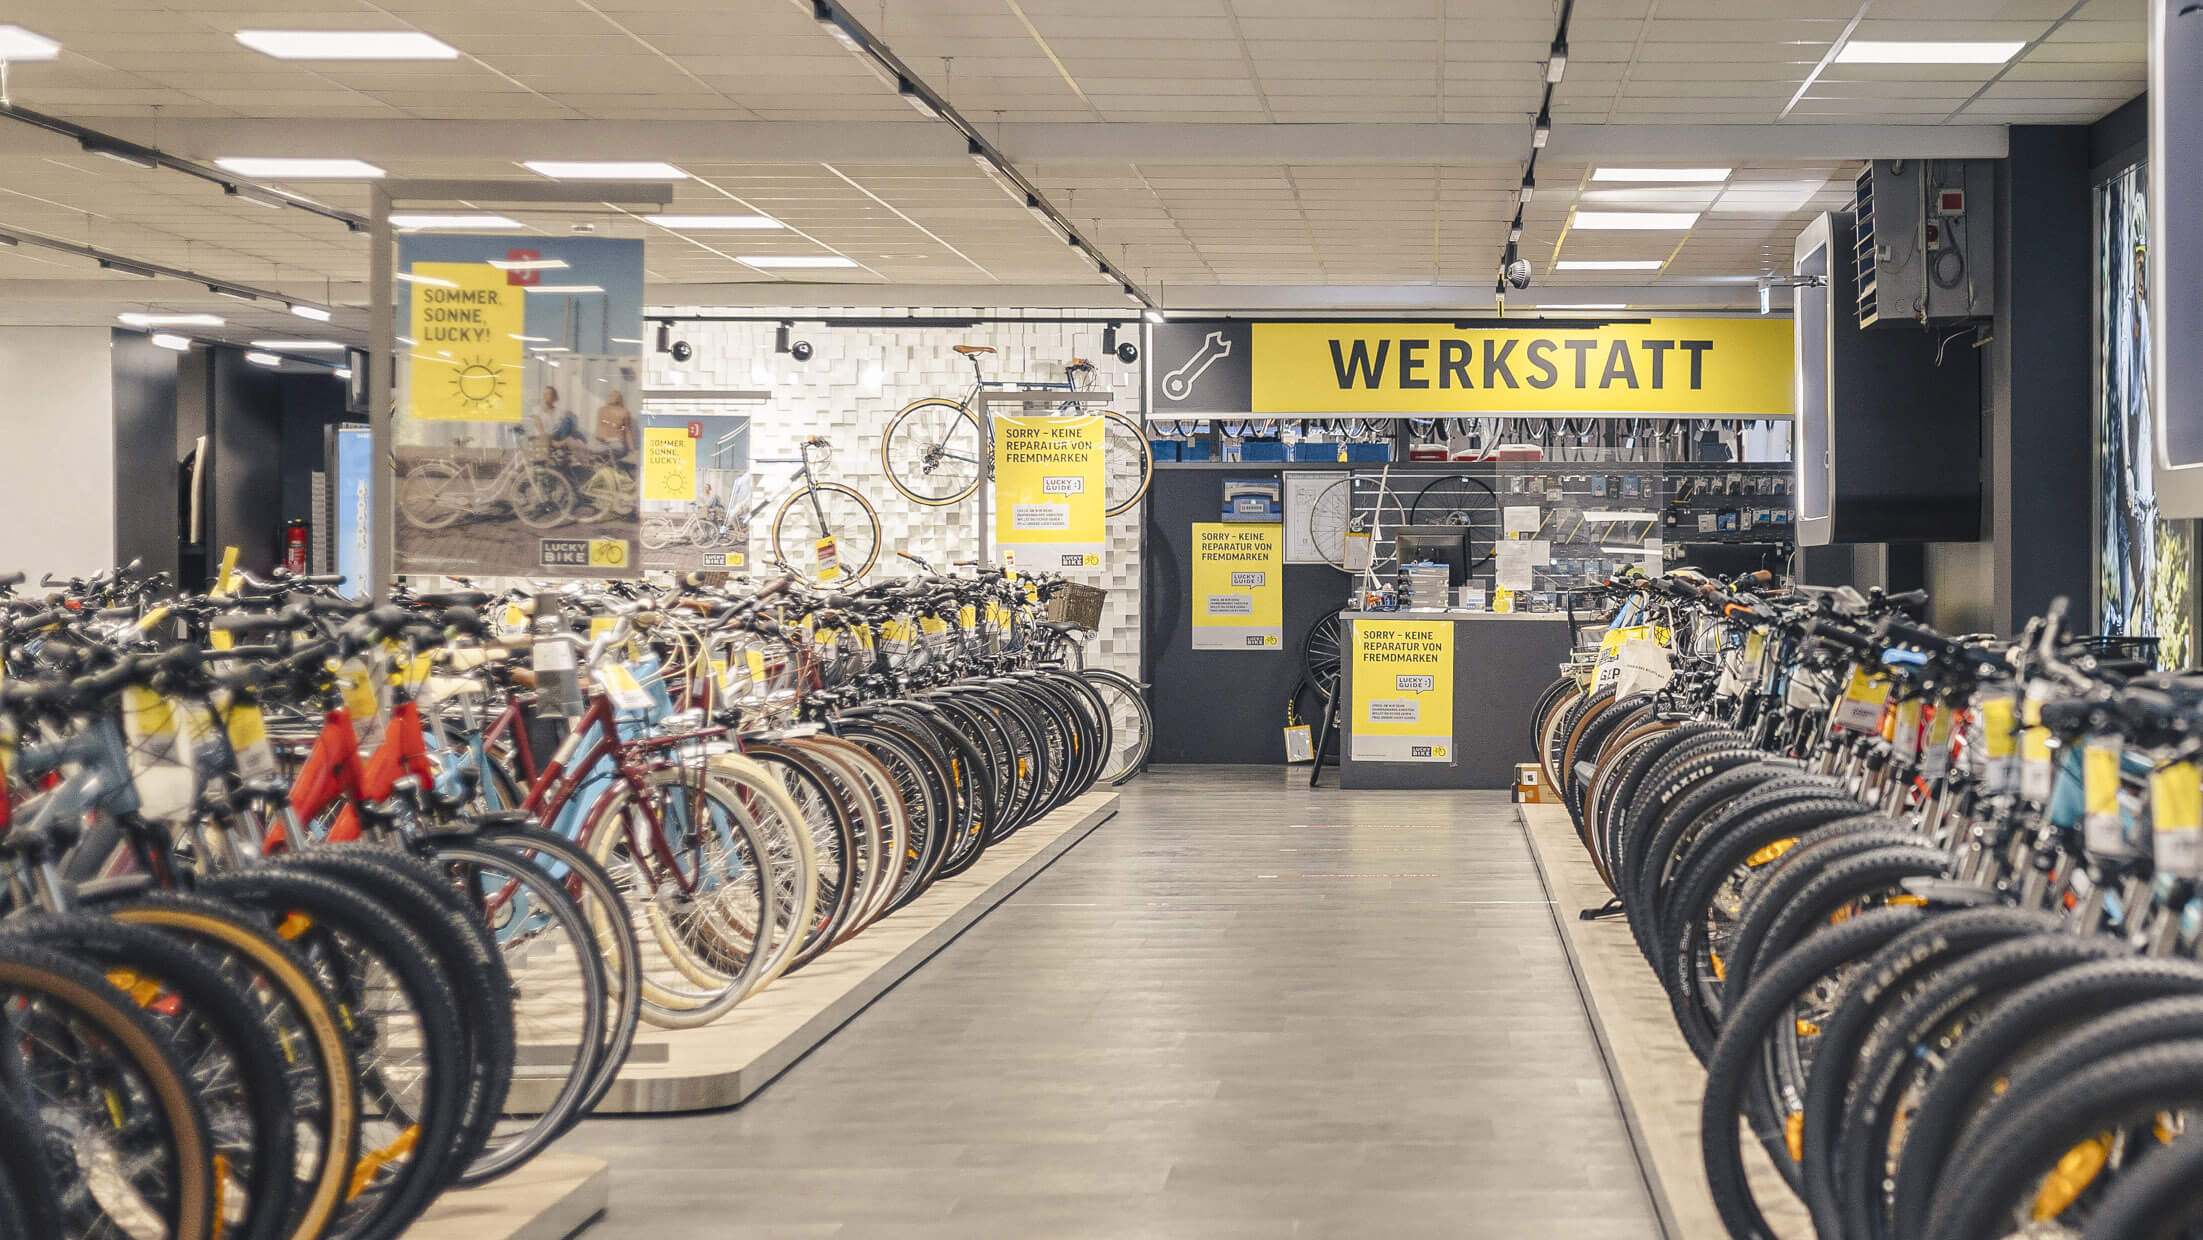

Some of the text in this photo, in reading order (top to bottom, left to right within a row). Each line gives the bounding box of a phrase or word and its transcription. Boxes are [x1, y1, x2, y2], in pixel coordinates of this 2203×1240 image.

[424, 326, 491, 342] LUCKY!
[1328, 339, 1713, 390] WERKSTATT
[1006, 428, 1040, 438] SORRY
[1051, 428, 1083, 438] KEINE
[1006, 441, 1092, 450] REPARATUR VON
[1006, 453, 1089, 463] FREMDMARKEN
[1201, 532, 1230, 541] SORRY
[1238, 532, 1265, 541] KEINE
[544, 543, 586, 552] LUCKY
[1201, 543, 1272, 551] REPARATUR VON
[544, 552, 586, 562] BIKE
[1201, 553, 1269, 561] FREMDMARKEN
[1363, 630, 1395, 640] SORRY
[1405, 631, 1433, 640] KEINE
[1363, 642, 1442, 651] REPARATUR VON
[1363, 653, 1438, 662] FREMDMARKEN
[1661, 765, 1714, 805] MAXXIS
